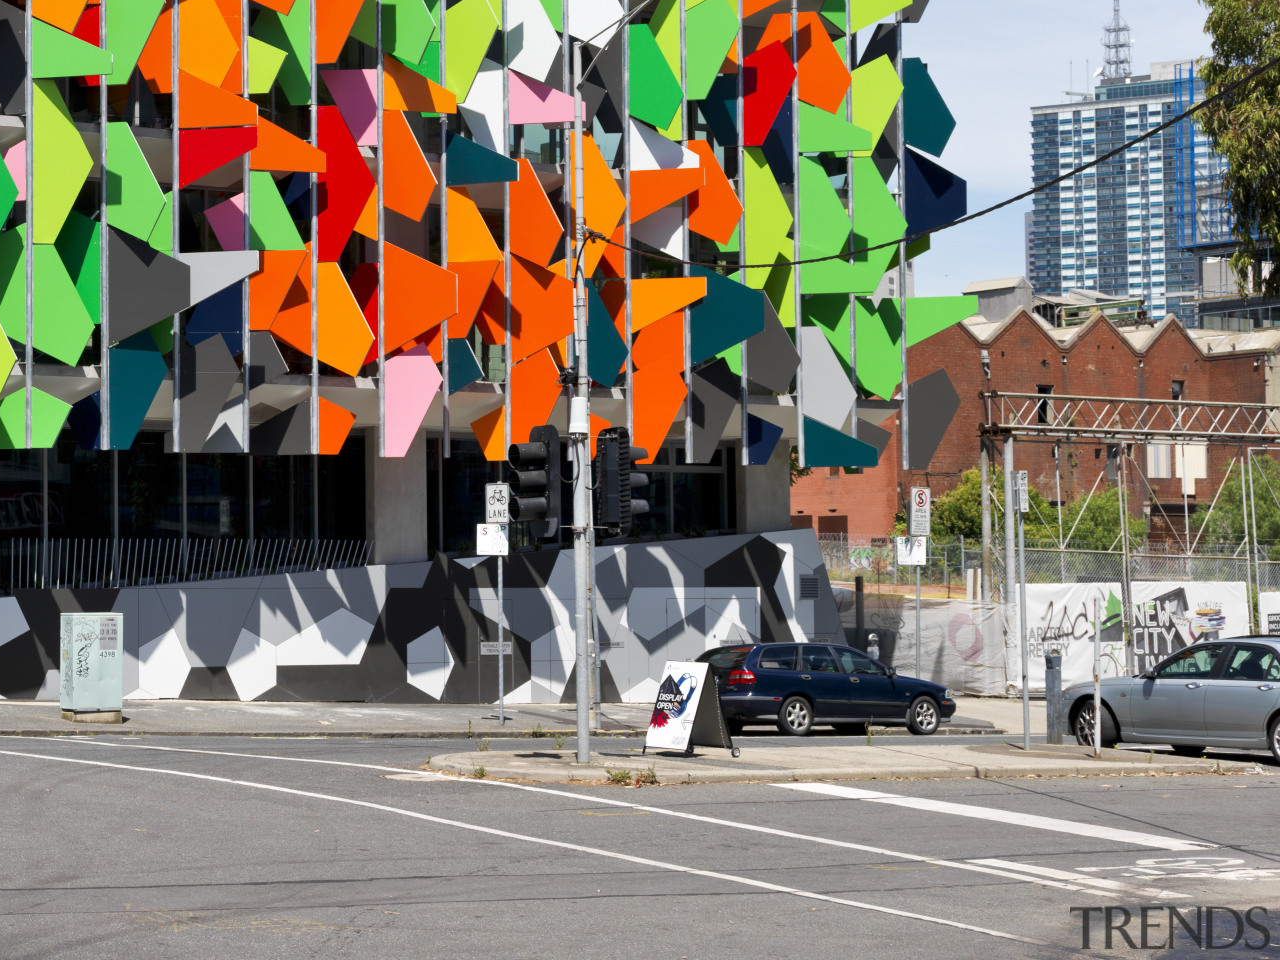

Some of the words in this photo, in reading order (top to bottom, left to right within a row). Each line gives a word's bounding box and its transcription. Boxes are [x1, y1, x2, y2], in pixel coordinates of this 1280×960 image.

[488, 509, 507, 518] LANE
[1131, 599, 1171, 627] NEW
[1133, 627, 1176, 654] CITY
[659, 693, 684, 702] DISPLAY
[656, 701, 674, 710] OPEN
